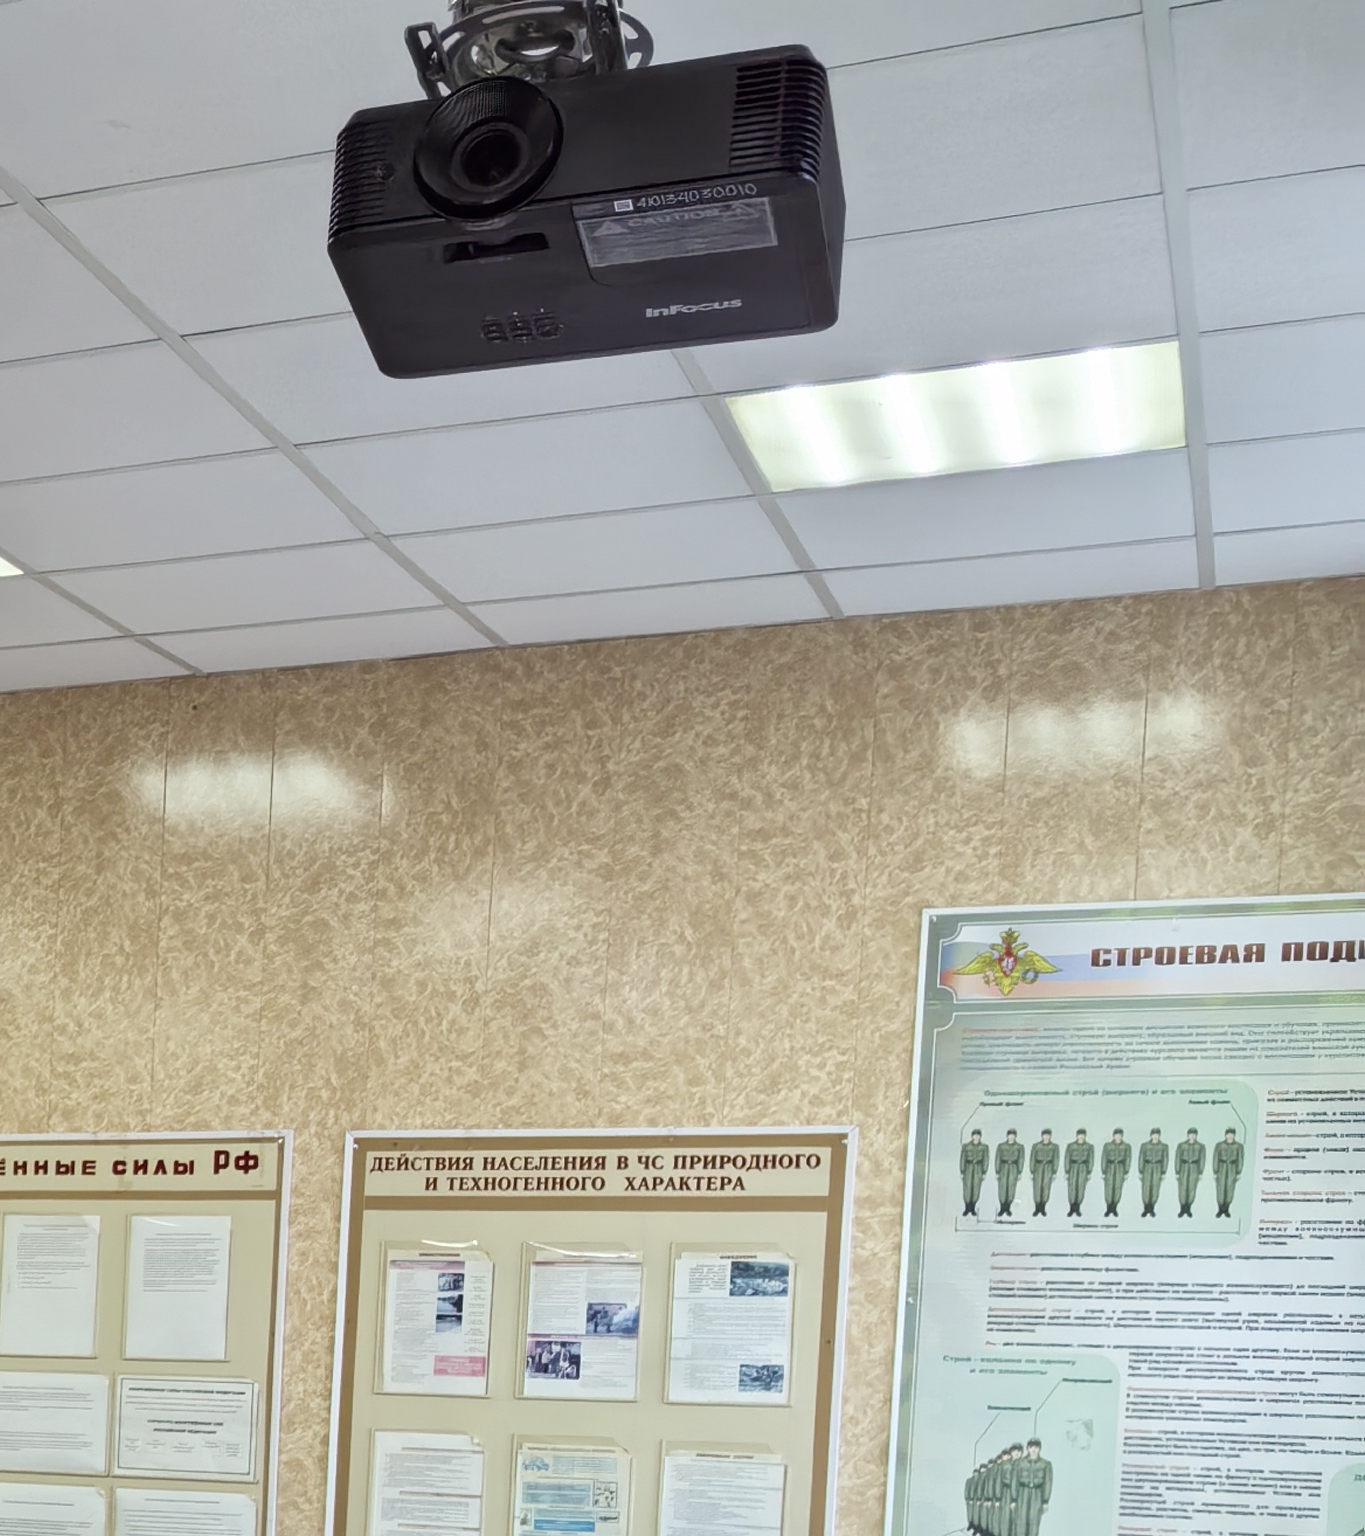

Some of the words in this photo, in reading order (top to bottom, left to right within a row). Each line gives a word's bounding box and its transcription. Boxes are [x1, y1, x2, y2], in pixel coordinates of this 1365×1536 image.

[645, 299, 742, 318] InFocus
[1090, 943, 1266, 968] СТРОЕВАЯ
[213, 1149, 259, 1175] РФ
[369, 1153, 474, 1174] ДЕЙСТВИЯ
[482, 1154, 607, 1172] НАСЕЛЕНИЯ
[616, 1154, 629, 1171] В
[637, 1153, 664, 1171] ЧС
[673, 1152, 822, 1173] ПРИРОДНОГО
[424, 1176, 438, 1192] И
[446, 1175, 606, 1193] ТЕХНОГЕННОГО
[623, 1175, 746, 1193] ХАРАКТЕРА
